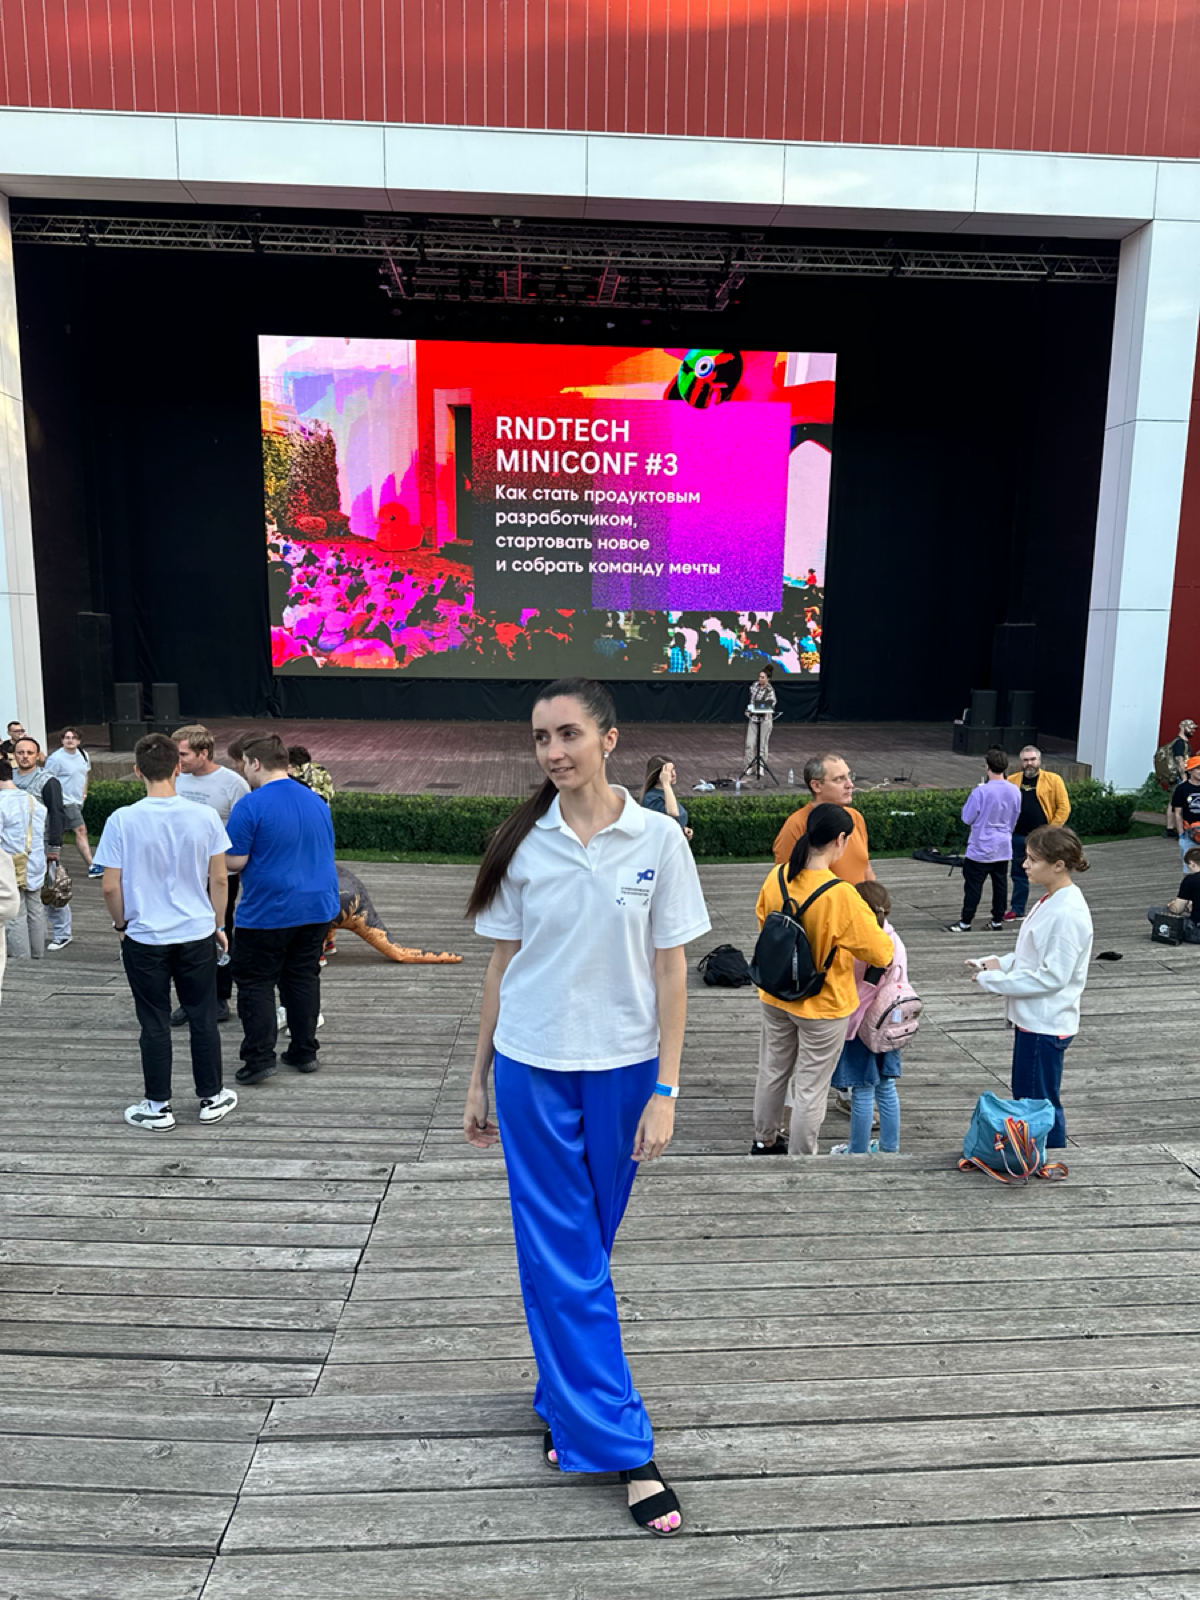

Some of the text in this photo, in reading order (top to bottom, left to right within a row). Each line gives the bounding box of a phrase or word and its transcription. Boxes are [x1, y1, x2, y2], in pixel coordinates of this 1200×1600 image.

[496, 416, 630, 443] RNDTECH
[496, 448, 678, 476] MINICONF #3
[495, 484, 701, 505] Как стать продуктовым
[495, 510, 637, 529] разработчиком,
[495, 535, 650, 551] стартовать новое
[495, 557, 721, 576] и собрать команду мечты
